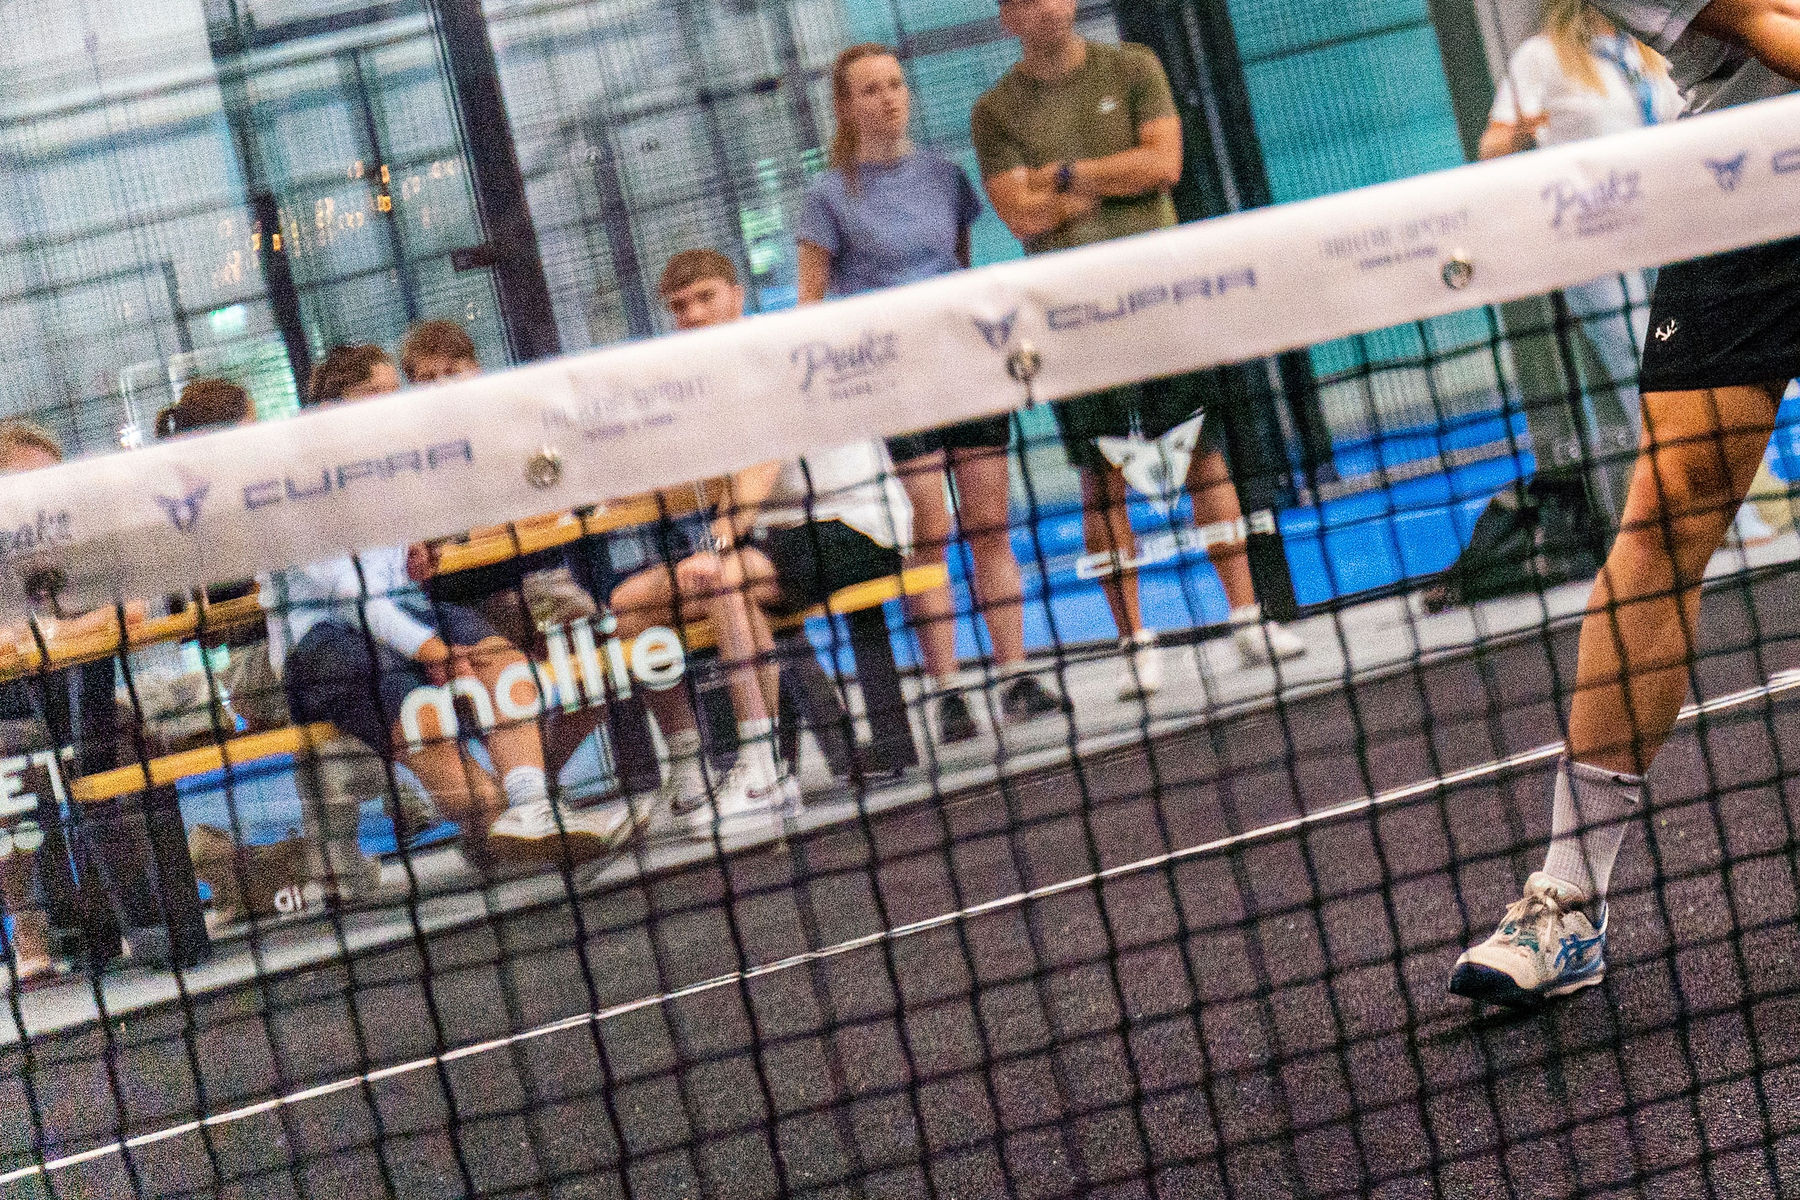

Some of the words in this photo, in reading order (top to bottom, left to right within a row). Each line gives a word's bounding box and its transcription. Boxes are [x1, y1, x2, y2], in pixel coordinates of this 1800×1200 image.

[1046, 266, 1258, 331] CUPRA
[243, 438, 475, 510] CUPRA
[401, 612, 685, 752] mollie
